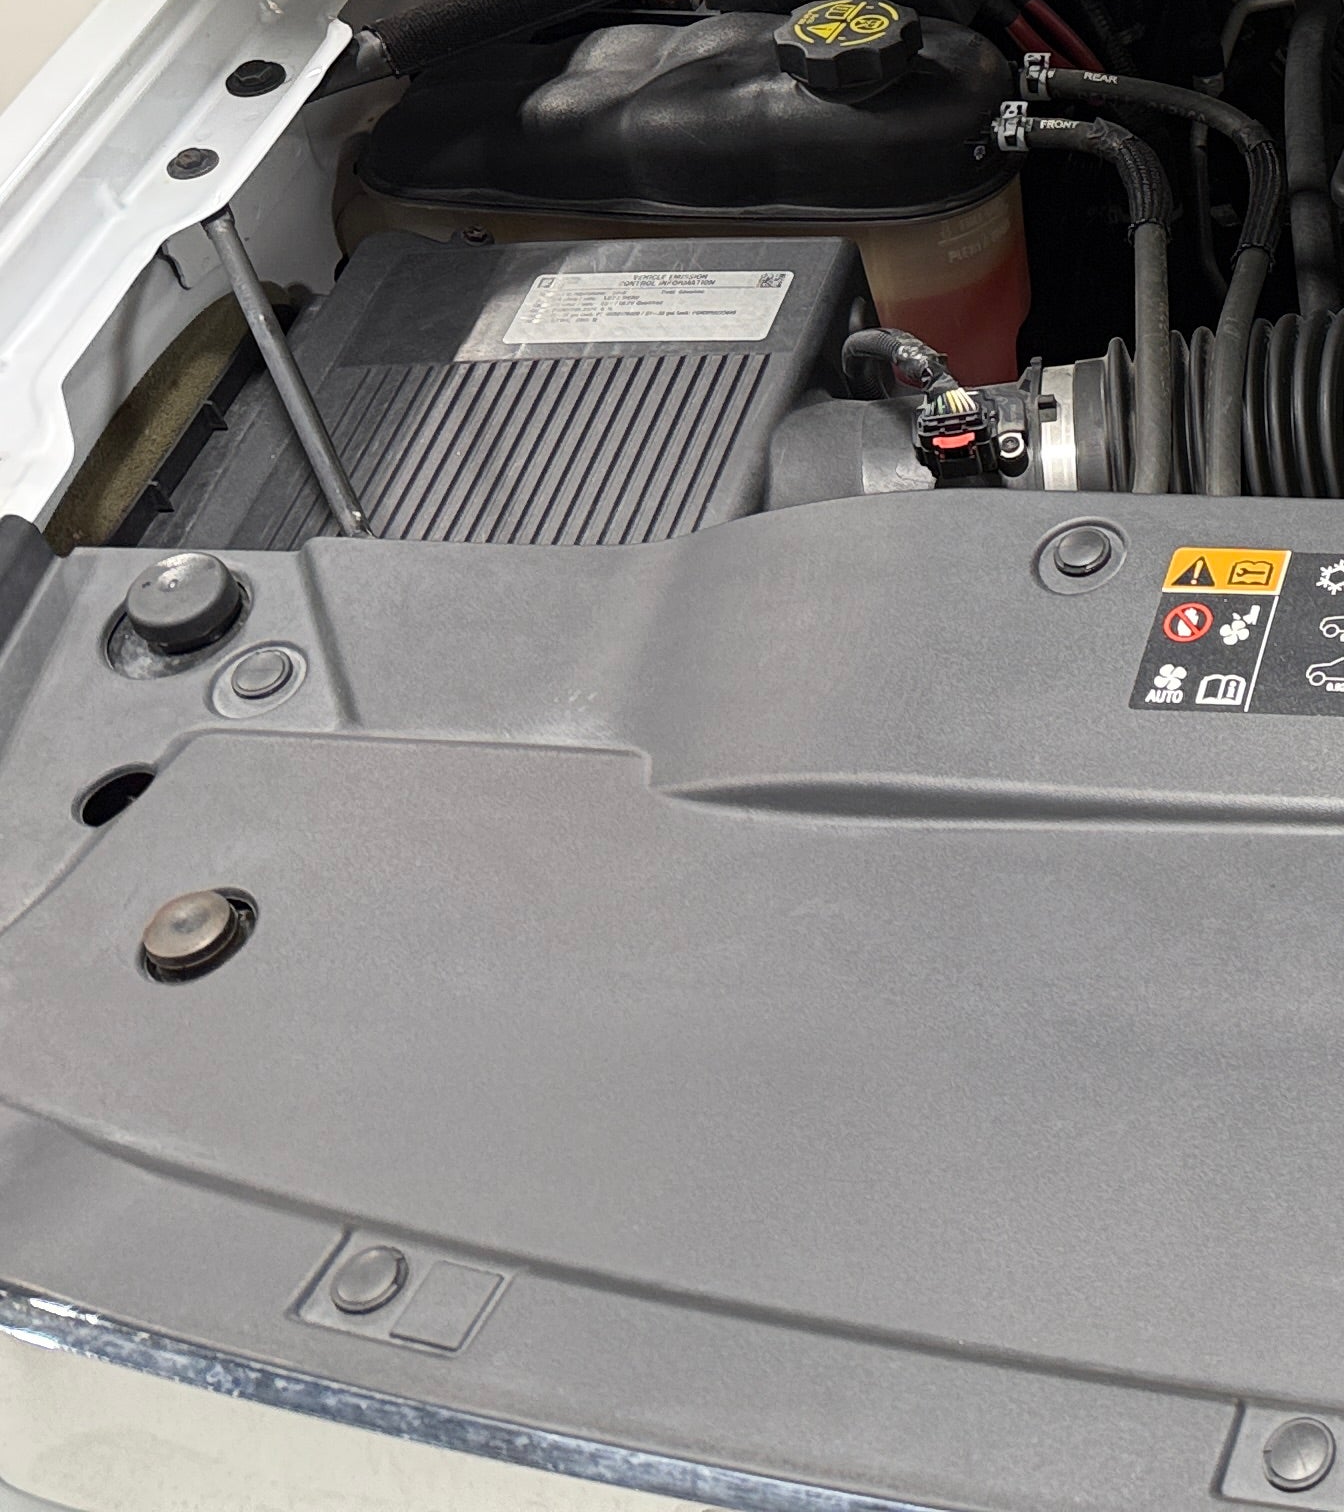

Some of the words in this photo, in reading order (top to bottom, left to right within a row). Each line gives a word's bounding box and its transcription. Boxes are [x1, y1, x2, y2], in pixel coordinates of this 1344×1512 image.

[1083, 71, 1118, 84] REAR
[1040, 119, 1080, 129] FRONT
[1145, 689, 1184, 703] AUTO
